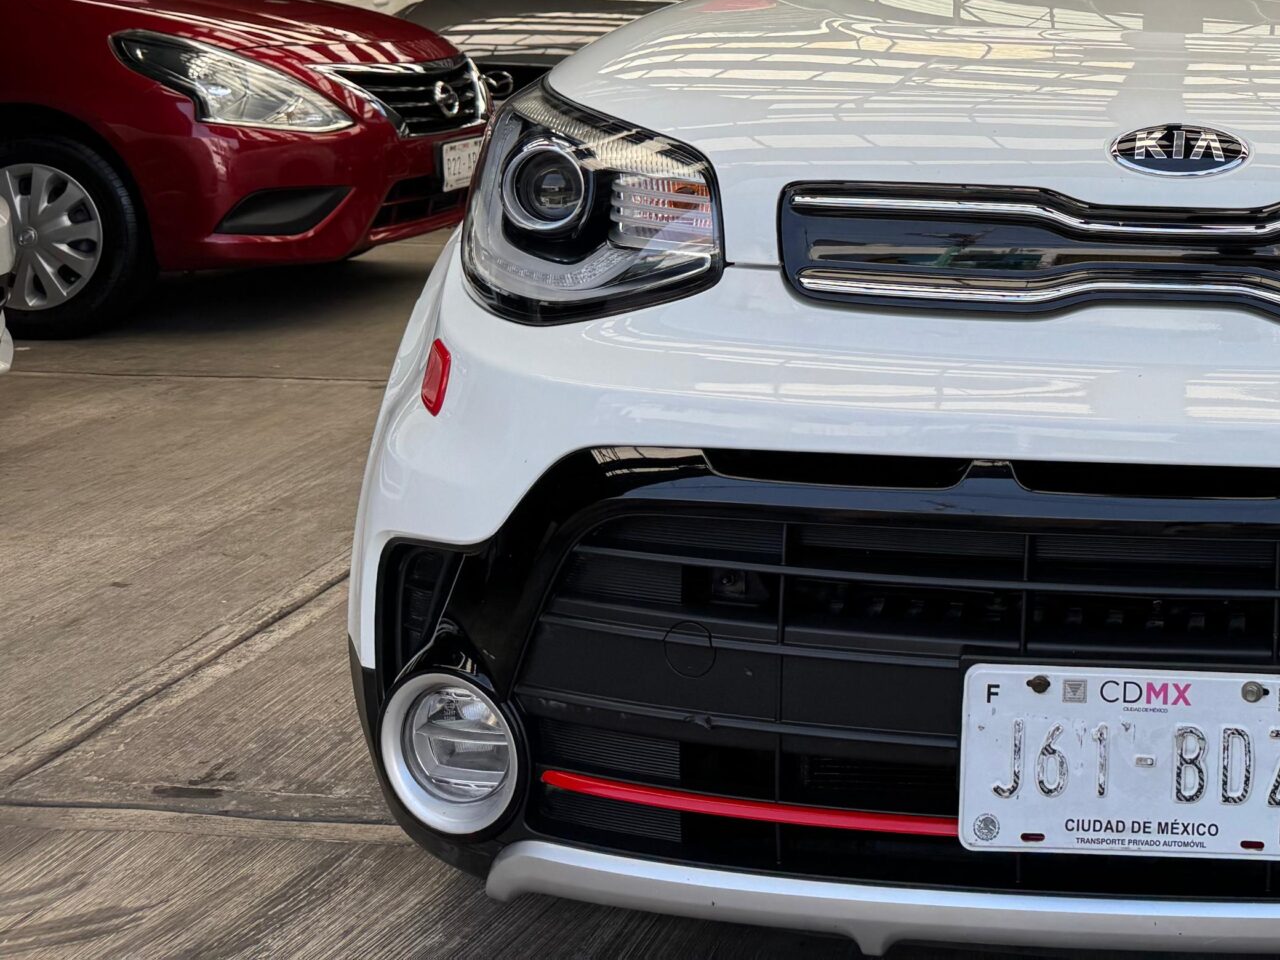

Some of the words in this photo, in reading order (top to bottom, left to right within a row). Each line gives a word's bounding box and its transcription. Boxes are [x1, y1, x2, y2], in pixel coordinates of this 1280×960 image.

[1134, 130, 1226, 162] KIA
[986, 683, 1000, 704] F
[1100, 679, 1192, 707] CDMX
[1064, 818, 1126, 834] CIUDAD
[1131, 820, 1152, 834] DE
[1157, 819, 1219, 837] MÉXICO
[1076, 837, 1126, 846] TRANSPORTE
[1128, 838, 1161, 847] PRIVADO
[1162, 839, 1207, 849] AUTOMÓVIL
